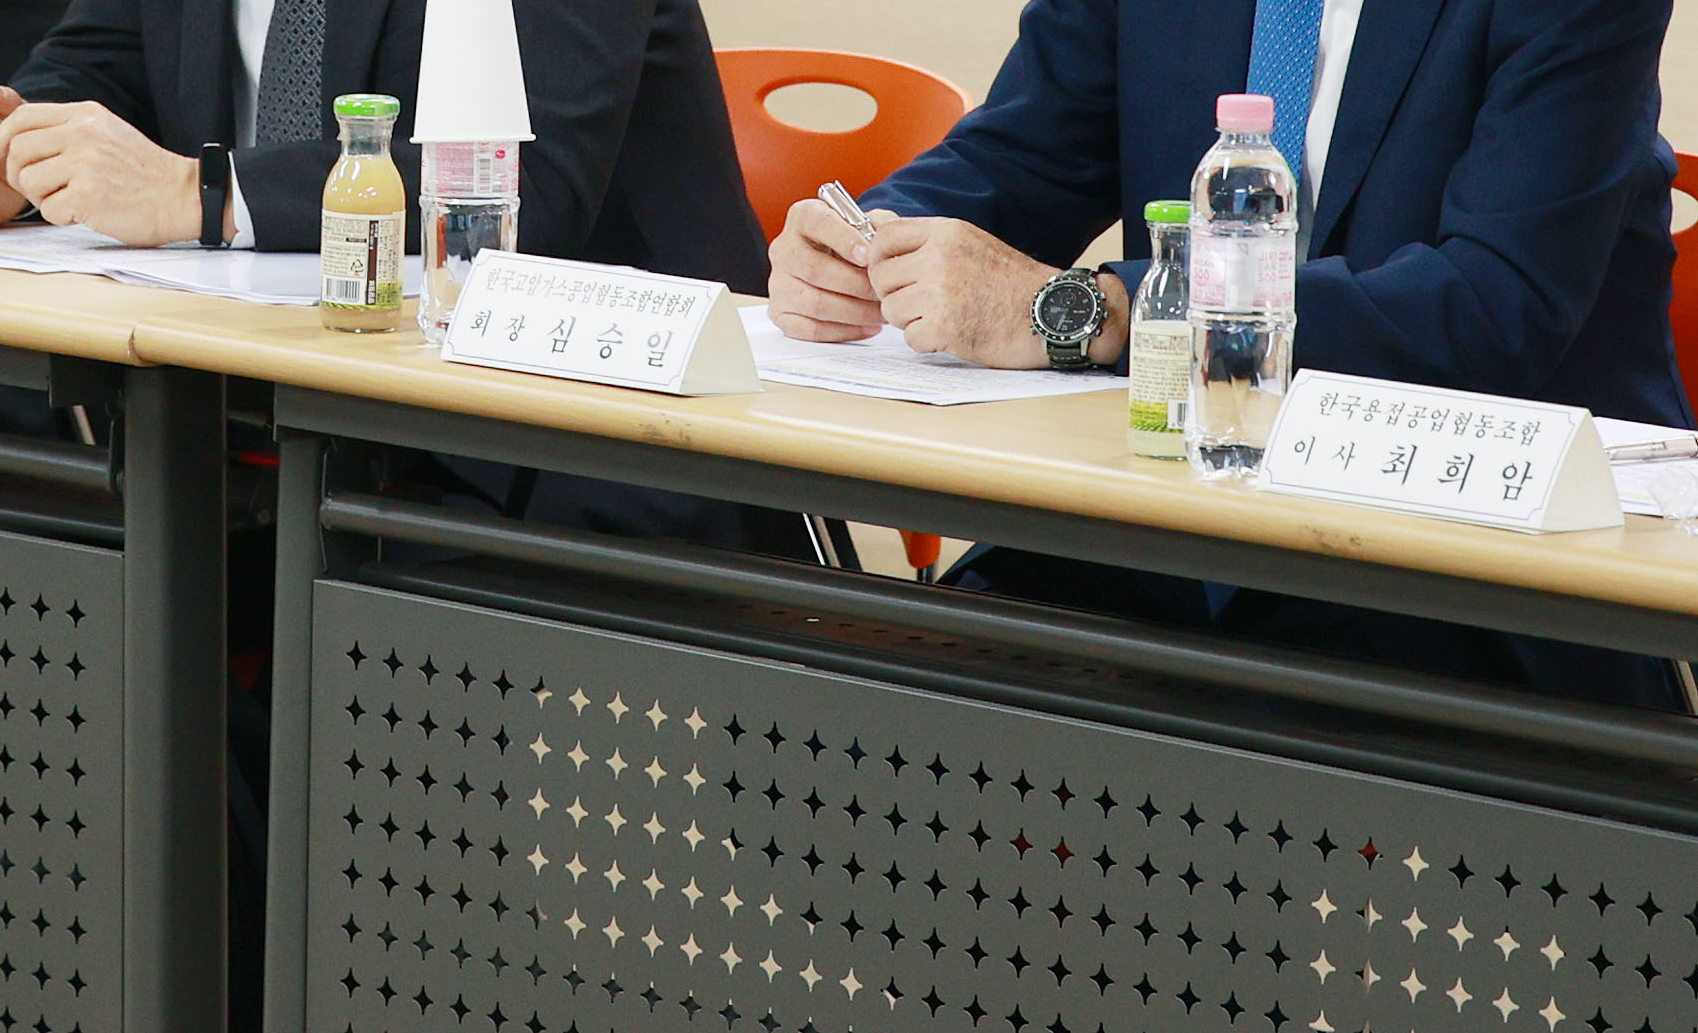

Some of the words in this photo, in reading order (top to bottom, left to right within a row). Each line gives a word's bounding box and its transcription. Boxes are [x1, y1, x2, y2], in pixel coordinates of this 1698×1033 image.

[486, 267, 696, 319] 한국고압가스공업협동조합연합회
[470, 310, 526, 342] 회장
[547, 316, 673, 368] 심승일
[1318, 391, 1542, 447] 한국용접공업협동조합
[1293, 434, 1356, 471] 이사
[1380, 442, 1534, 501] 최희암
